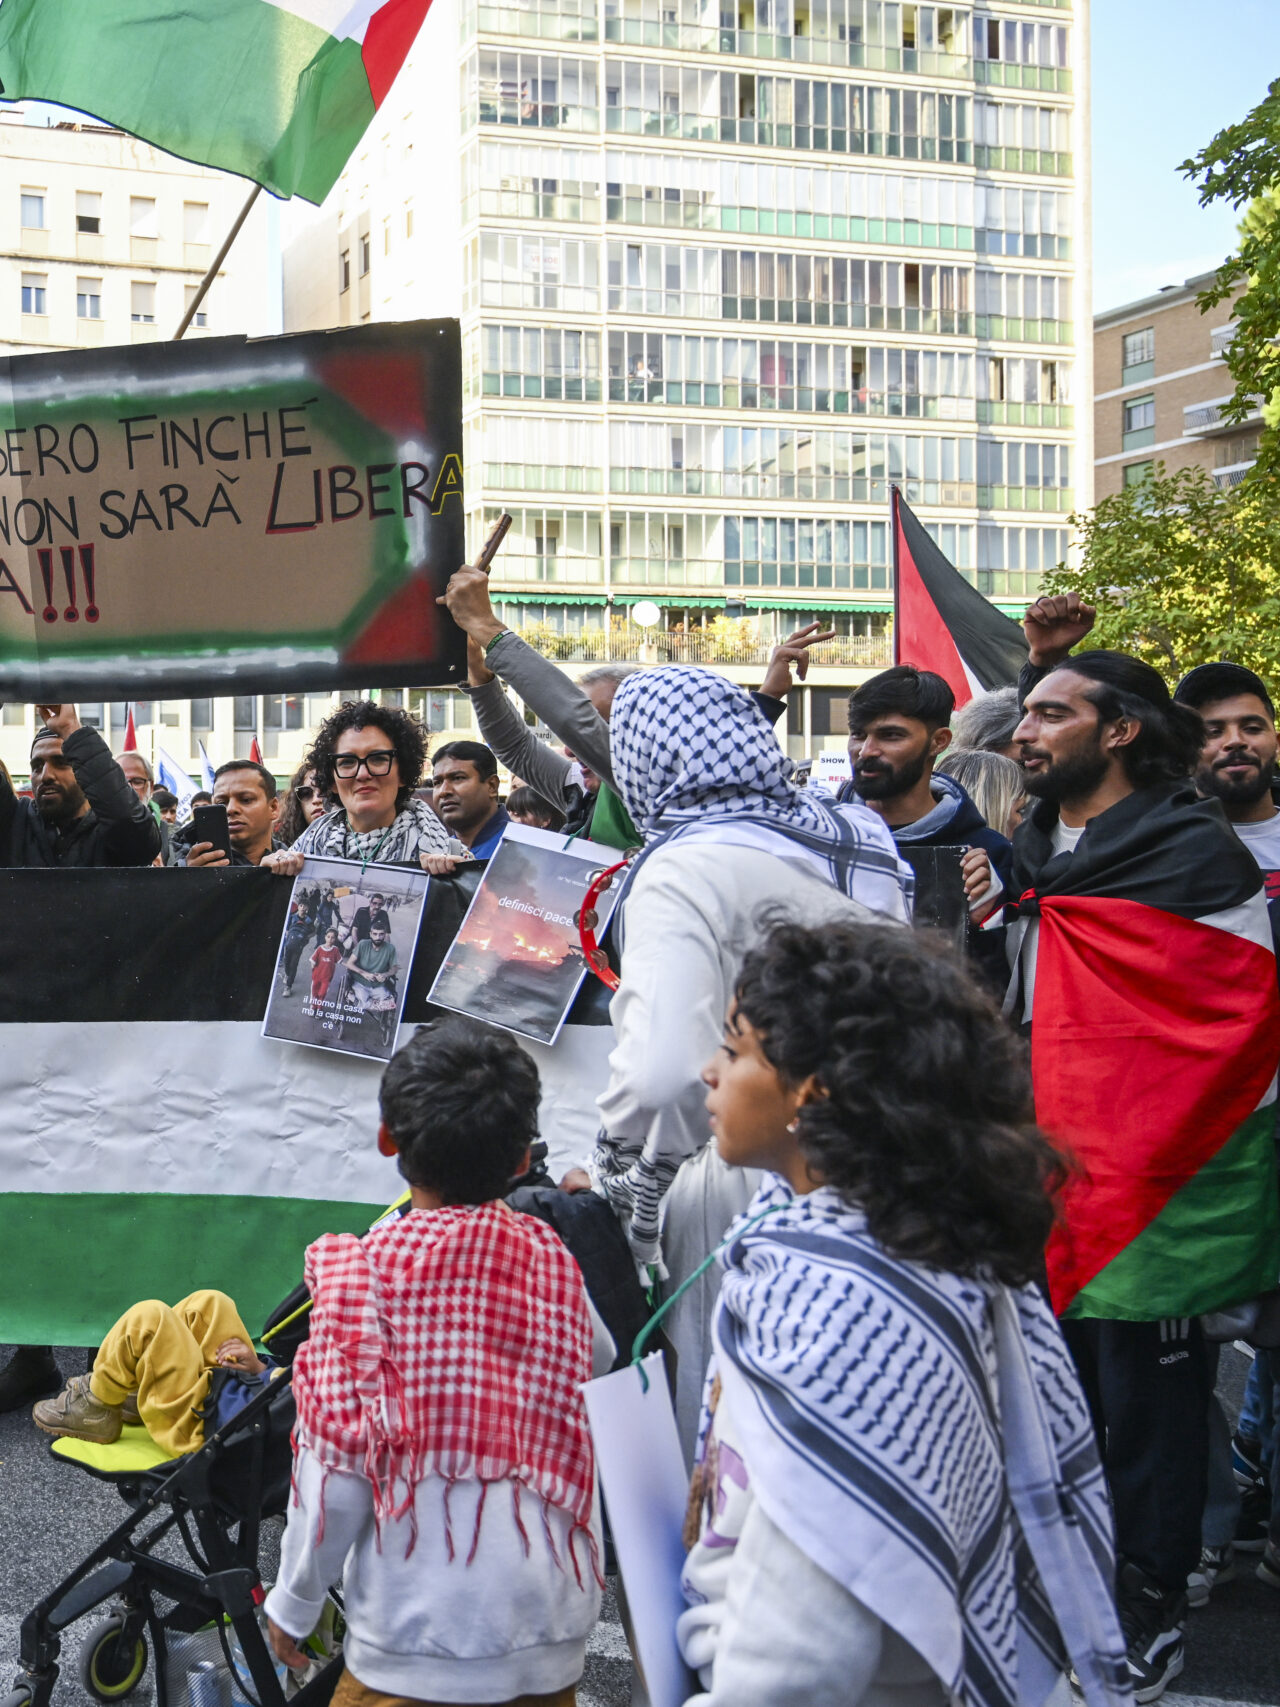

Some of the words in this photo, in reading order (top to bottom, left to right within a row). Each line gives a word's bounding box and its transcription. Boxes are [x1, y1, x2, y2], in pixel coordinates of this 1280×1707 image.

[118, 397, 319, 470] FINCHÉ
[99, 469, 242, 539] SARÀ
[265, 453, 464, 534] LIBERA
[498, 895, 545, 918] definisci
[543, 911, 574, 927] pace
[301, 1007, 314, 1017] ma
[317, 1009, 324, 1017] la
[325, 1012, 345, 1021] casa
[345, 1015, 362, 1024] non
[303, 995, 309, 1004] il
[343, 1004, 365, 1015] casa,
